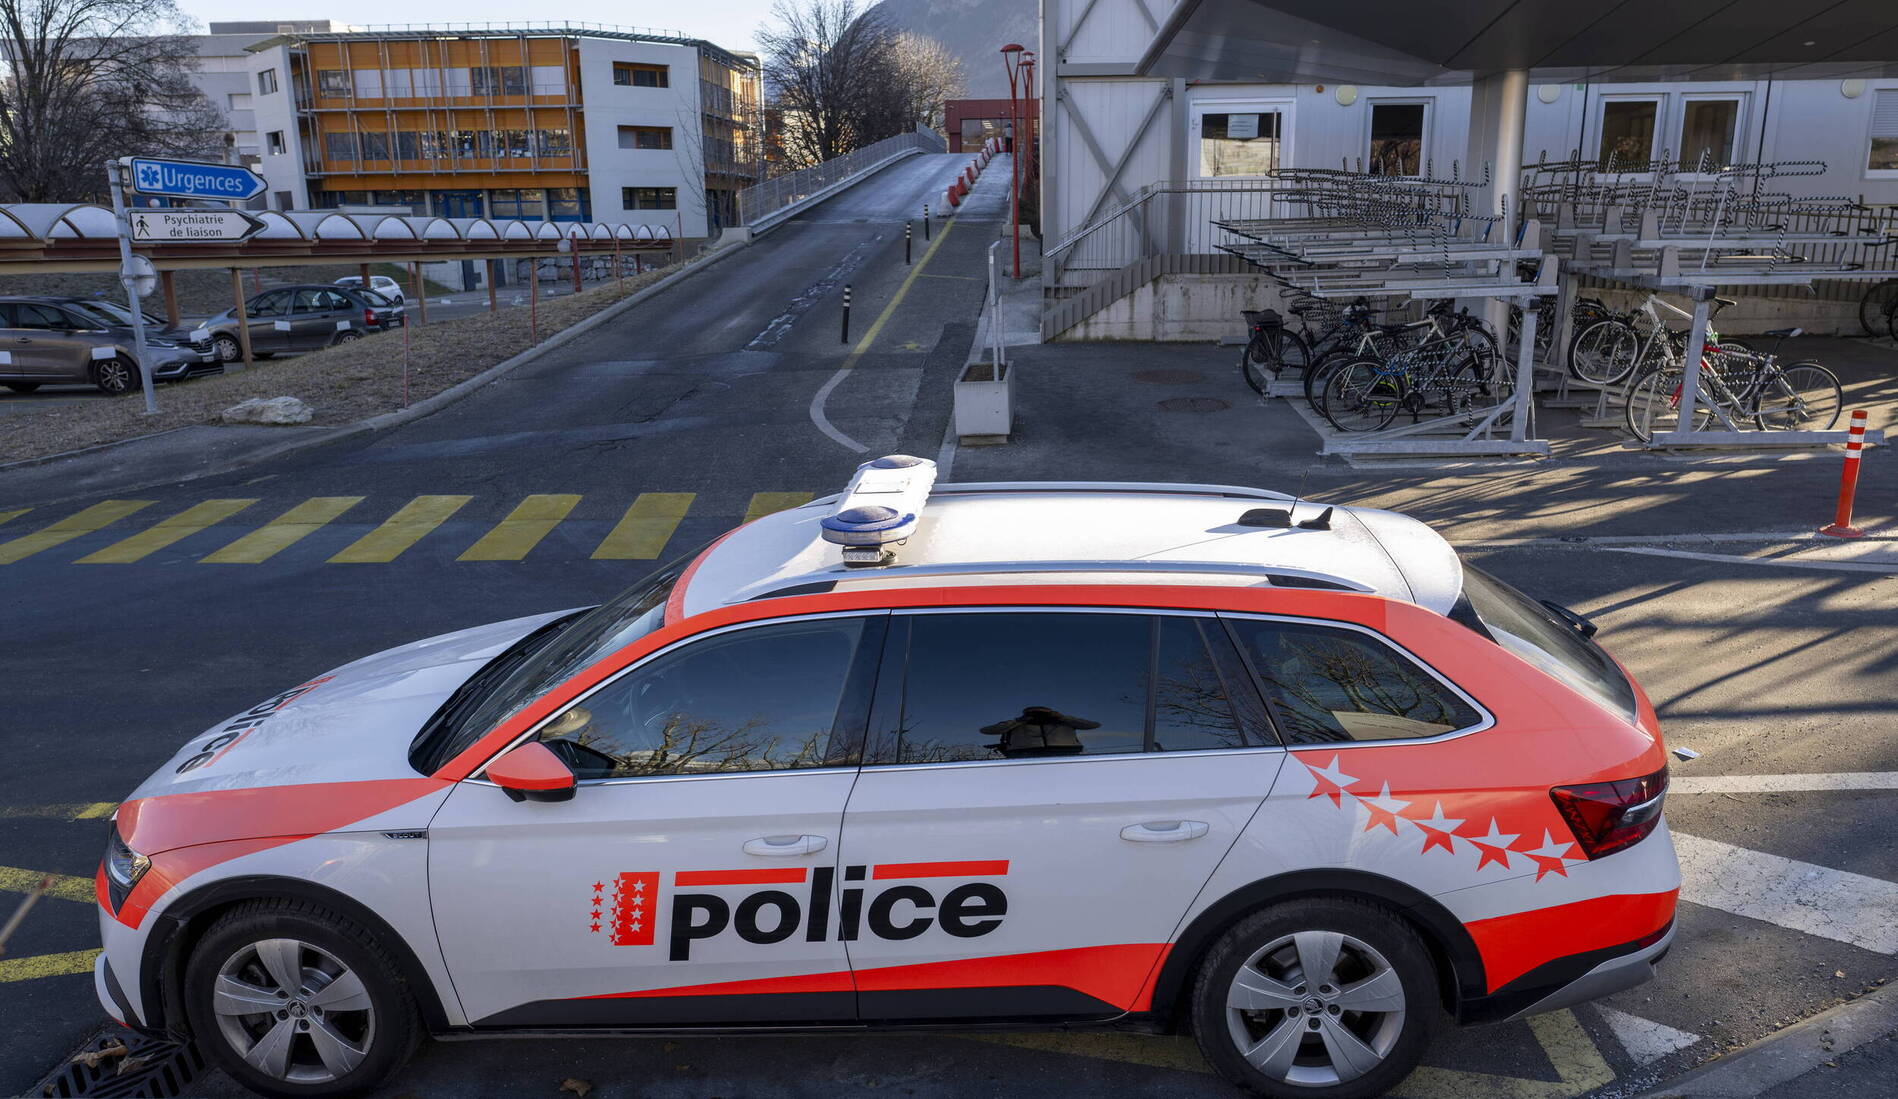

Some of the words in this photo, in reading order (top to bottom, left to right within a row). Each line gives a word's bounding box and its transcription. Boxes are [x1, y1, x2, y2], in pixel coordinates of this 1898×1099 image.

[164, 168, 243, 192] Urgences
[164, 215, 224, 227] Psychiatrie
[169, 228, 183, 238] de
[186, 228, 223, 238] liaison
[175, 687, 309, 775] police
[669, 864, 1009, 961] police
